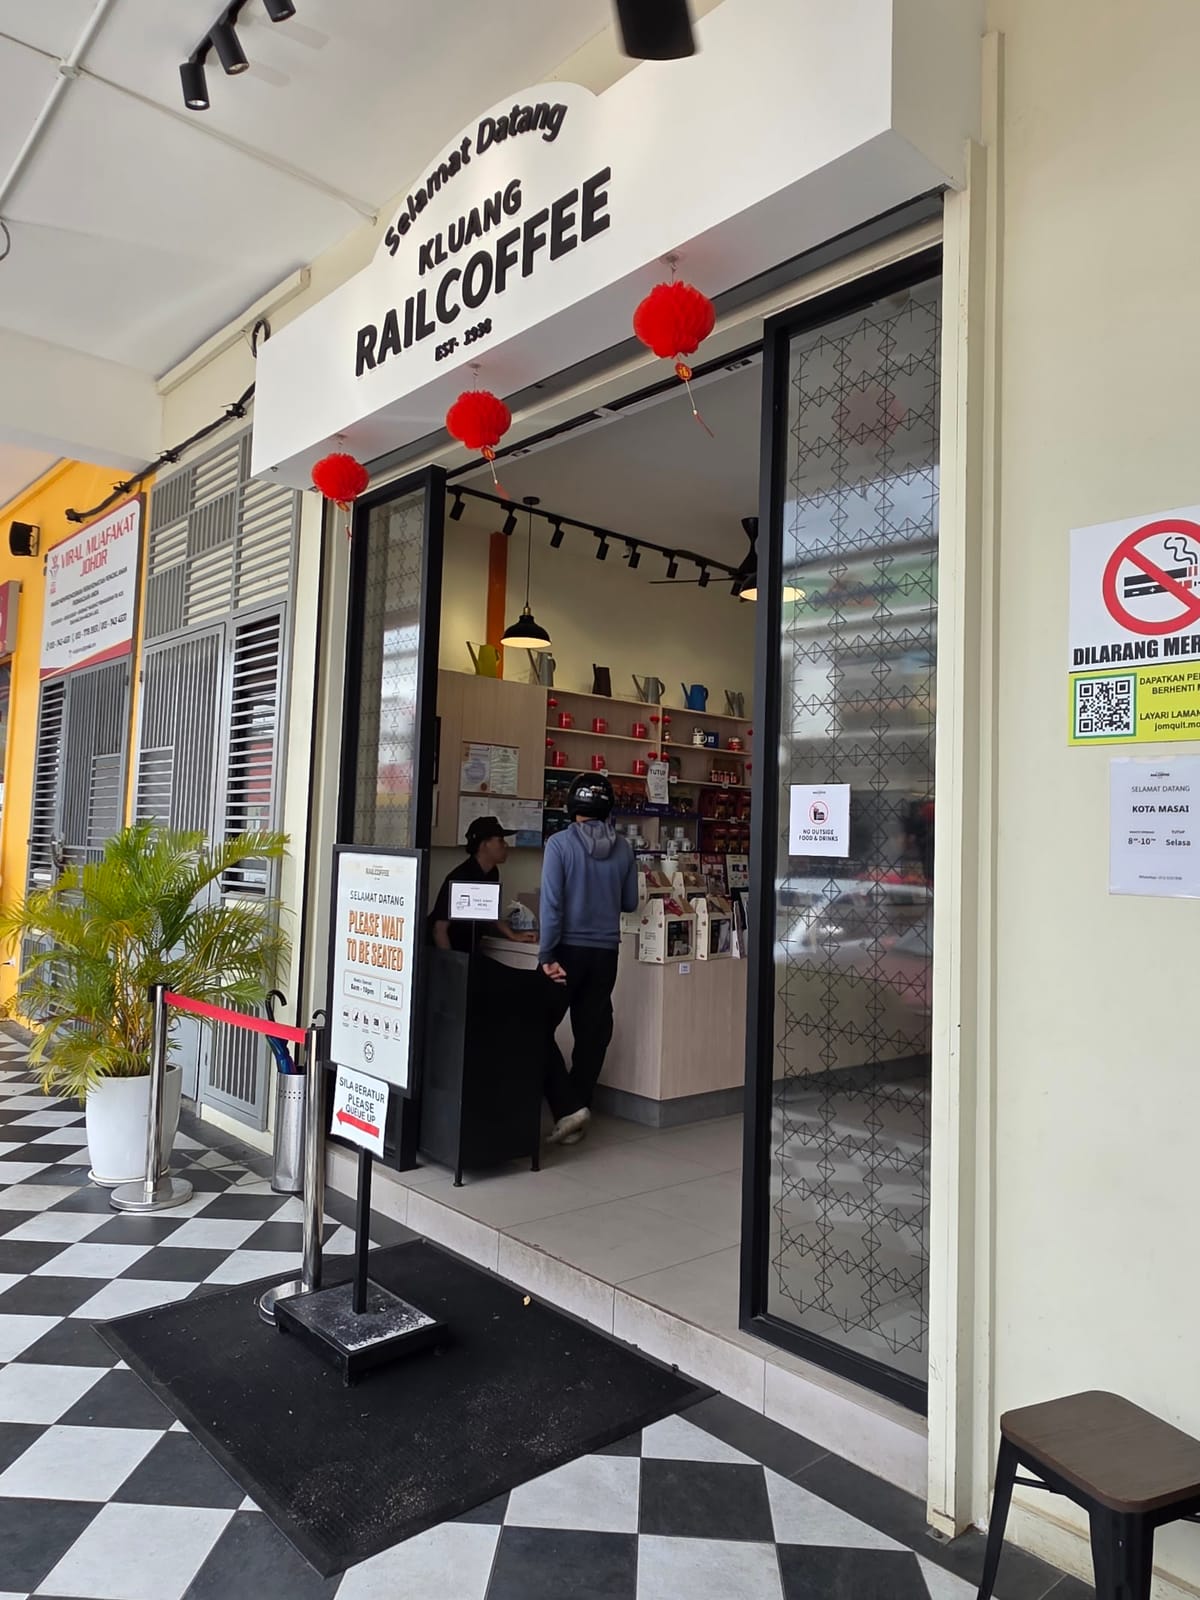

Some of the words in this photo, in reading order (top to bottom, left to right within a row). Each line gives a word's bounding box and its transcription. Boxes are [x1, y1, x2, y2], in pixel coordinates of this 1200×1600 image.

[384, 136, 472, 256] Selamat
[476, 102, 568, 154] Datang
[418, 179, 522, 276] KLUANG
[355, 166, 611, 377] RAILCOFFEE
[61, 544, 84, 569] VIRAL
[86, 512, 136, 554] MUAFAKAT
[80, 548, 108, 577] JOHOR
[1073, 639, 1159, 665] DILARANG
[1140, 674, 1185, 685] DAPATKAN
[1187, 672, 1200, 681] PE
[1152, 684, 1195, 694] BERHENTI
[1140, 711, 1169, 720] LAYARI
[1132, 805, 1156, 813] KOTA
[1158, 805, 1189, 813] MASAI
[350, 890, 378, 903] SELAMAT
[378, 893, 405, 907] DATANG
[349, 910, 380, 938] PLEASE
[381, 914, 405, 942] WAIT
[347, 937, 357, 962] TO
[359, 940, 370, 965] BE
[371, 943, 404, 972] SEATED
[339, 1077, 354, 1090] SILA
[354, 1083, 385, 1104] BERATUR
[345, 1104, 366, 1121] QUEUE
[367, 1112, 376, 1123] UP
[348, 1094, 375, 1114] PLEASE
